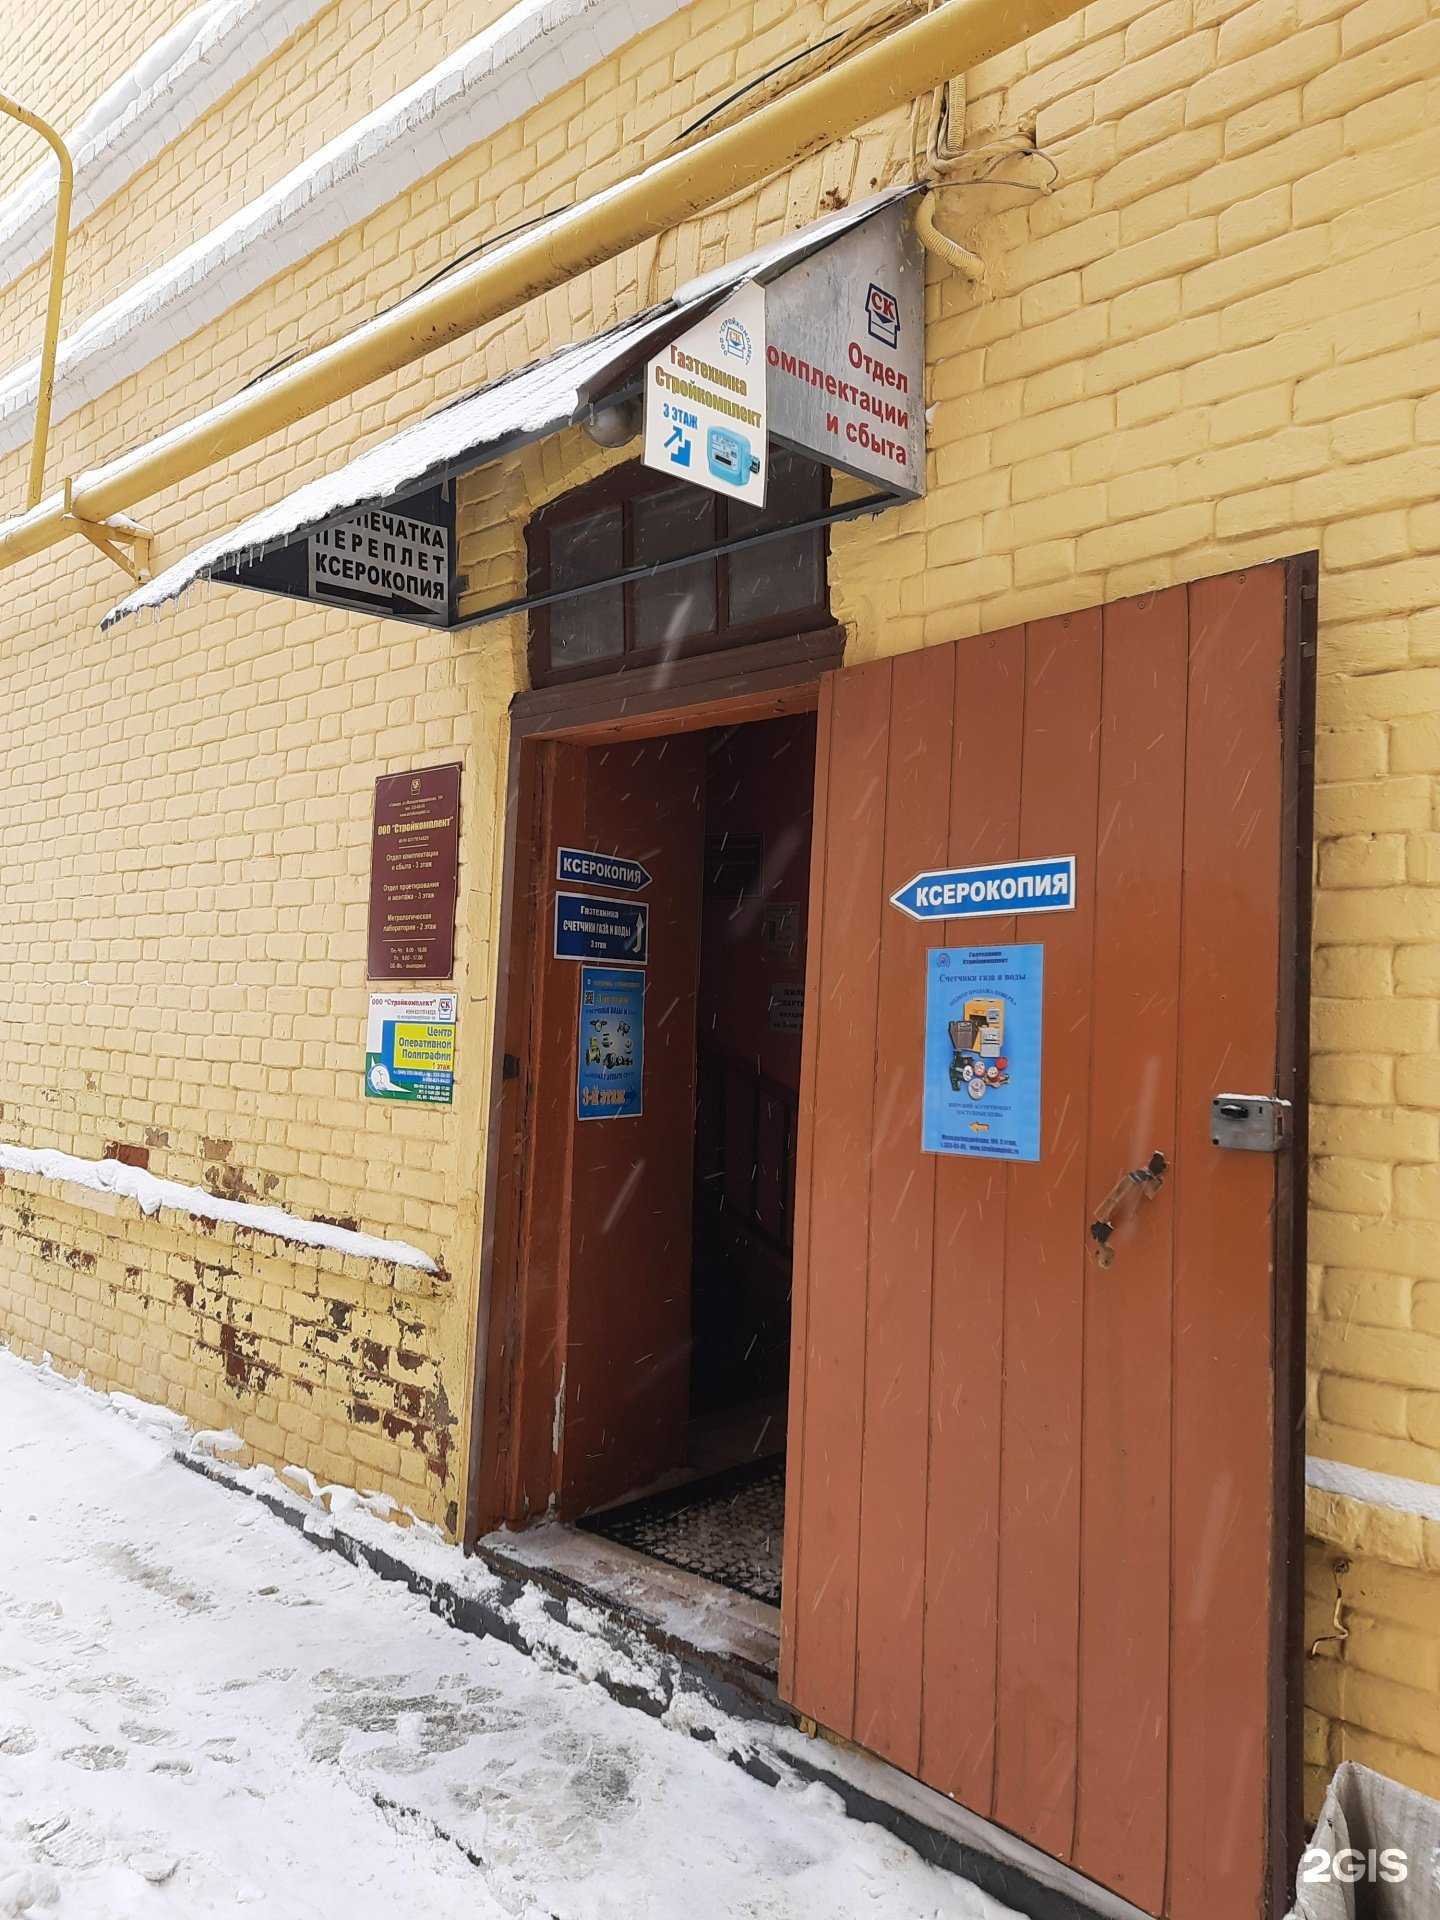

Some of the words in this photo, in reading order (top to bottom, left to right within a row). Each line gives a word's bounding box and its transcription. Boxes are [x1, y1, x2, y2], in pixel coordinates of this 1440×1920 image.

[871, 291, 894, 317] СК
[670, 344, 747, 397] Газтехника
[848, 341, 908, 394] Отдел
[655, 366, 762, 429] Стройкомплект
[765, 345, 908, 430] омплектации
[663, 403, 669, 418] 3
[827, 413, 838, 434] и
[847, 421, 907, 465] сбыта
[348, 511, 444, 549] ПЕЧАТКА
[315, 529, 445, 574] ПЕРЕПЛЕТ
[315, 552, 444, 600] КСЕРОКОПИЯ
[563, 857, 641, 884] КСЕРОКОПИЯ
[916, 872, 1068, 907] КСЕРОКОПИЯ
[580, 905, 619, 919] Газтехника
[563, 920, 596, 934] СЧЕТЧИКИ
[595, 921, 609, 934] ГАЗА
[609, 925, 614, 934] И
[614, 925, 631, 937] ВОДЫ
[590, 940, 594, 948] 3
[939, 974, 977, 984] Счетчики
[1004, 973, 1026, 981] воды
[371, 998, 383, 1006] ООО
[384, 998, 437, 1007] "Стройкомплект"
[440, 1001, 450, 1009] СК
[398, 1037, 452, 1049] Оперативной
[427, 1025, 452, 1037] Центр
[402, 1049, 451, 1061] Полиграфии
